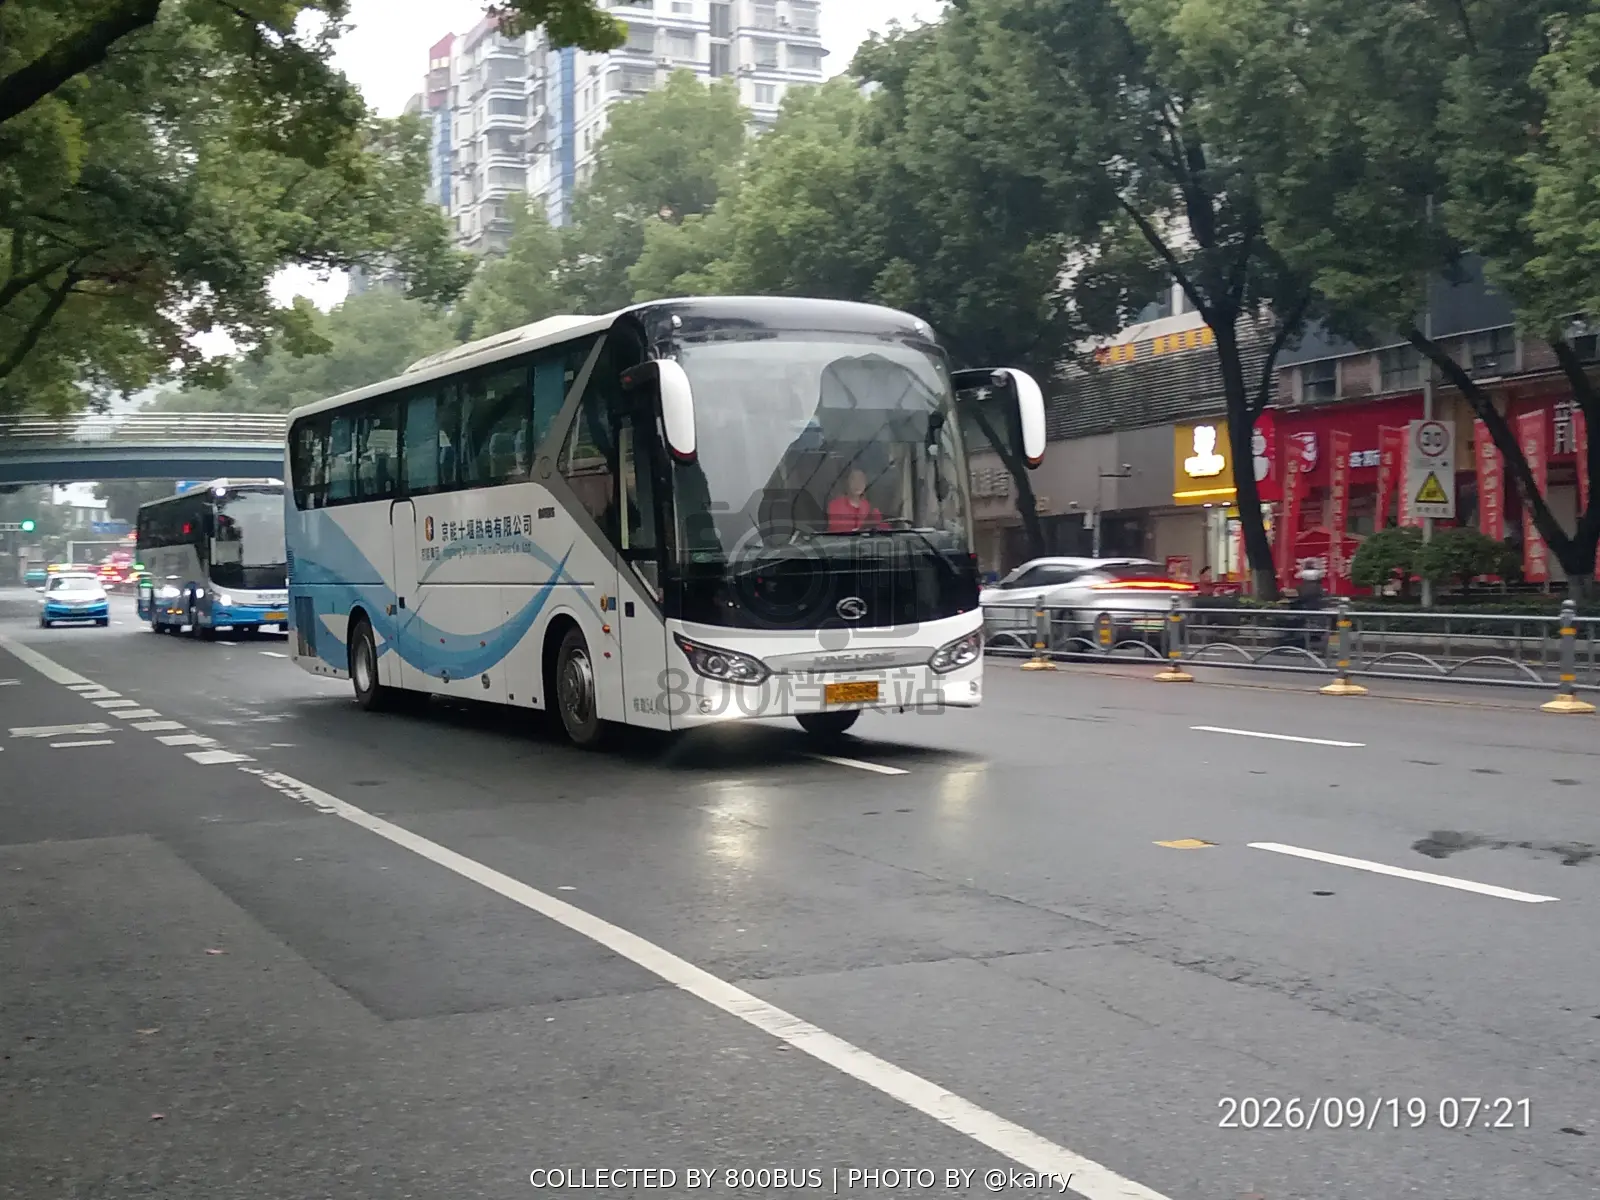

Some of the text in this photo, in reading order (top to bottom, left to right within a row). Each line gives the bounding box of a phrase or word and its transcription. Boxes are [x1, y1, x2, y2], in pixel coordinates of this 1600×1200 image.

[441, 514, 532, 542] 京能十堰热电有限公司
